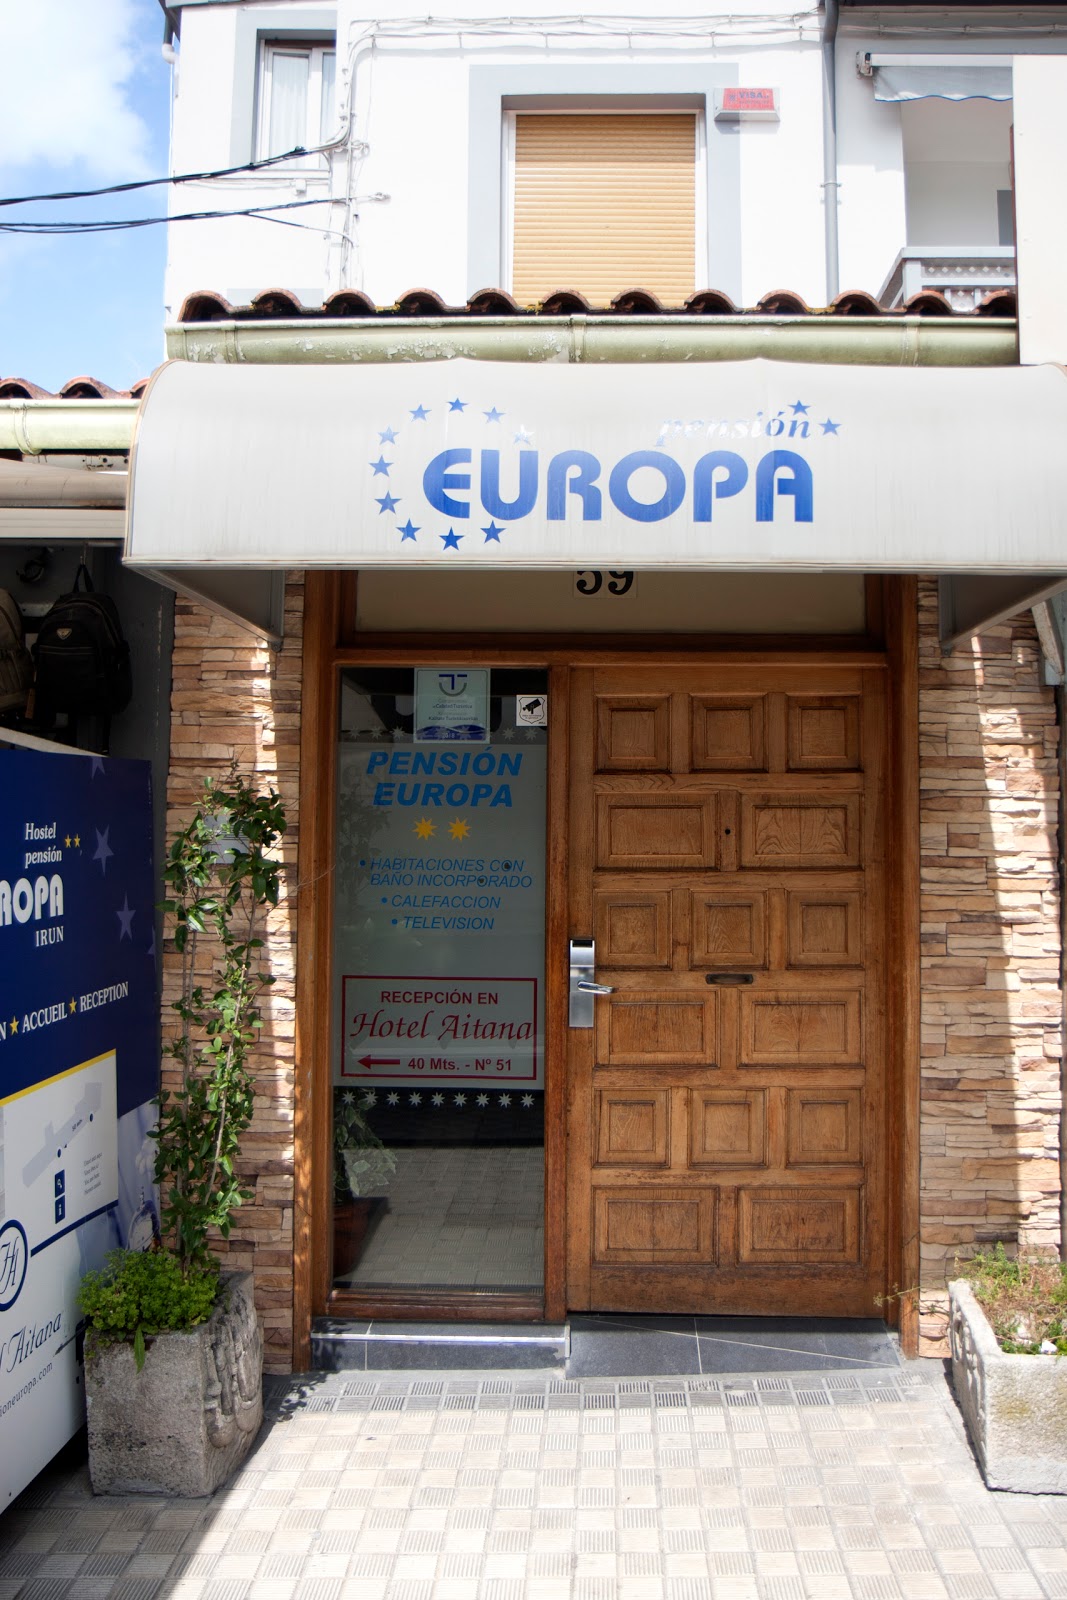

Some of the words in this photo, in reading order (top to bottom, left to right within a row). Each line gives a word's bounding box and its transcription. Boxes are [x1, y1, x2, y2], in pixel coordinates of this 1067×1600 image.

[654, 411, 811, 447] pensión
[422, 448, 814, 523] EUROPA
[576, 570, 634, 596] 59
[366, 746, 523, 777] PENSIÓN
[373, 782, 513, 808] EUROPA
[25, 822, 57, 840] Hostel
[25, 845, 62, 869] pensión
[370, 858, 485, 872] HABITACIONES
[489, 859, 525, 872] CON
[370, 871, 414, 886] BAÑO
[417, 874, 532, 888] INCORPORADO
[391, 894, 501, 909] CALEFACCION
[403, 916, 495, 930] TELEVISION
[36, 926, 64, 947] IRUN
[22, 1002, 68, 1034] ACCUEIL
[80, 981, 129, 1013] RECEPTION
[380, 988, 472, 1005] RECEPCIÓN
[477, 992, 498, 1005] EN
[350, 1009, 435, 1039] Hotel
[437, 1013, 535, 1041] Aitana
[407, 1058, 425, 1070] 40
[430, 1058, 460, 1070] Mts.
[496, 1059, 512, 1071] 51
[6, 1313, 62, 1373] Aitana
